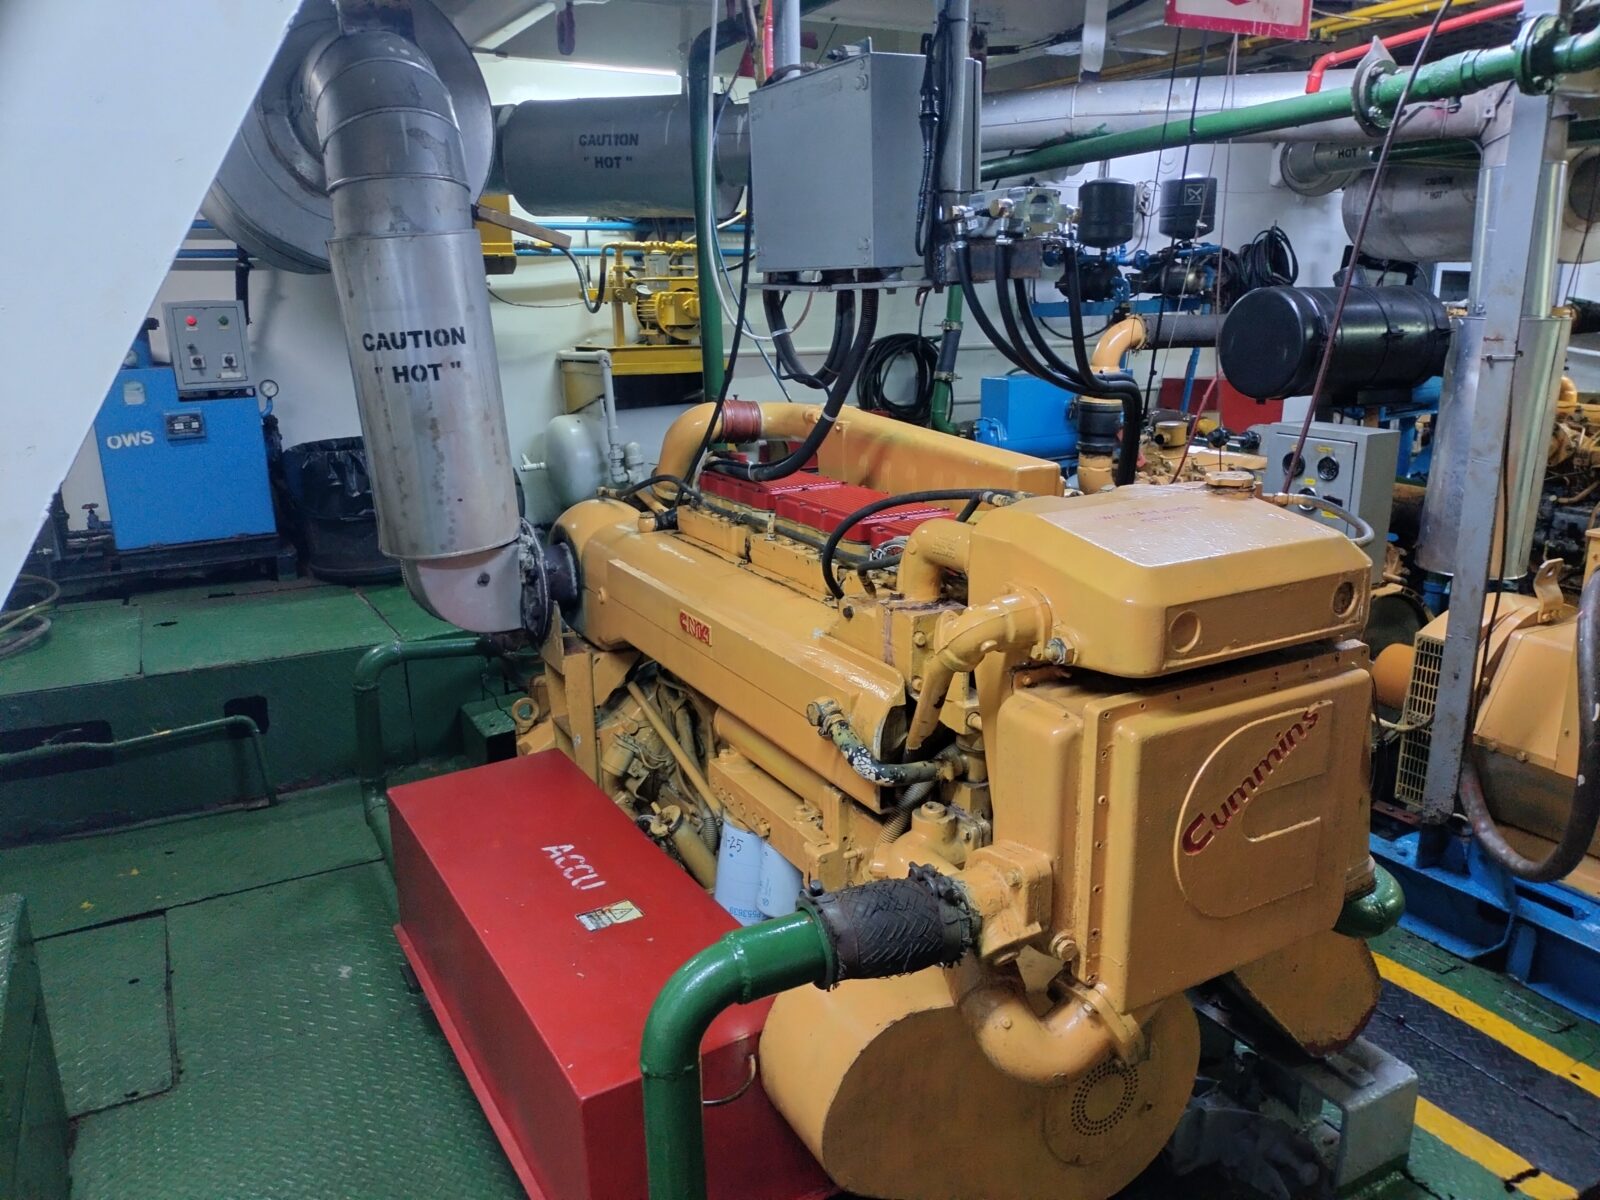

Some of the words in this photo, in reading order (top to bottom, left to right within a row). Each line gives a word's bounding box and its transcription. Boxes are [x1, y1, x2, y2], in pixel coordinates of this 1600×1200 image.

[579, 133, 639, 146] CAUTION
[362, 326, 467, 352] CAUTION
[106, 430, 154, 450] OWS
[1182, 710, 1319, 855] Cummins
[541, 844, 607, 890] ACCU
